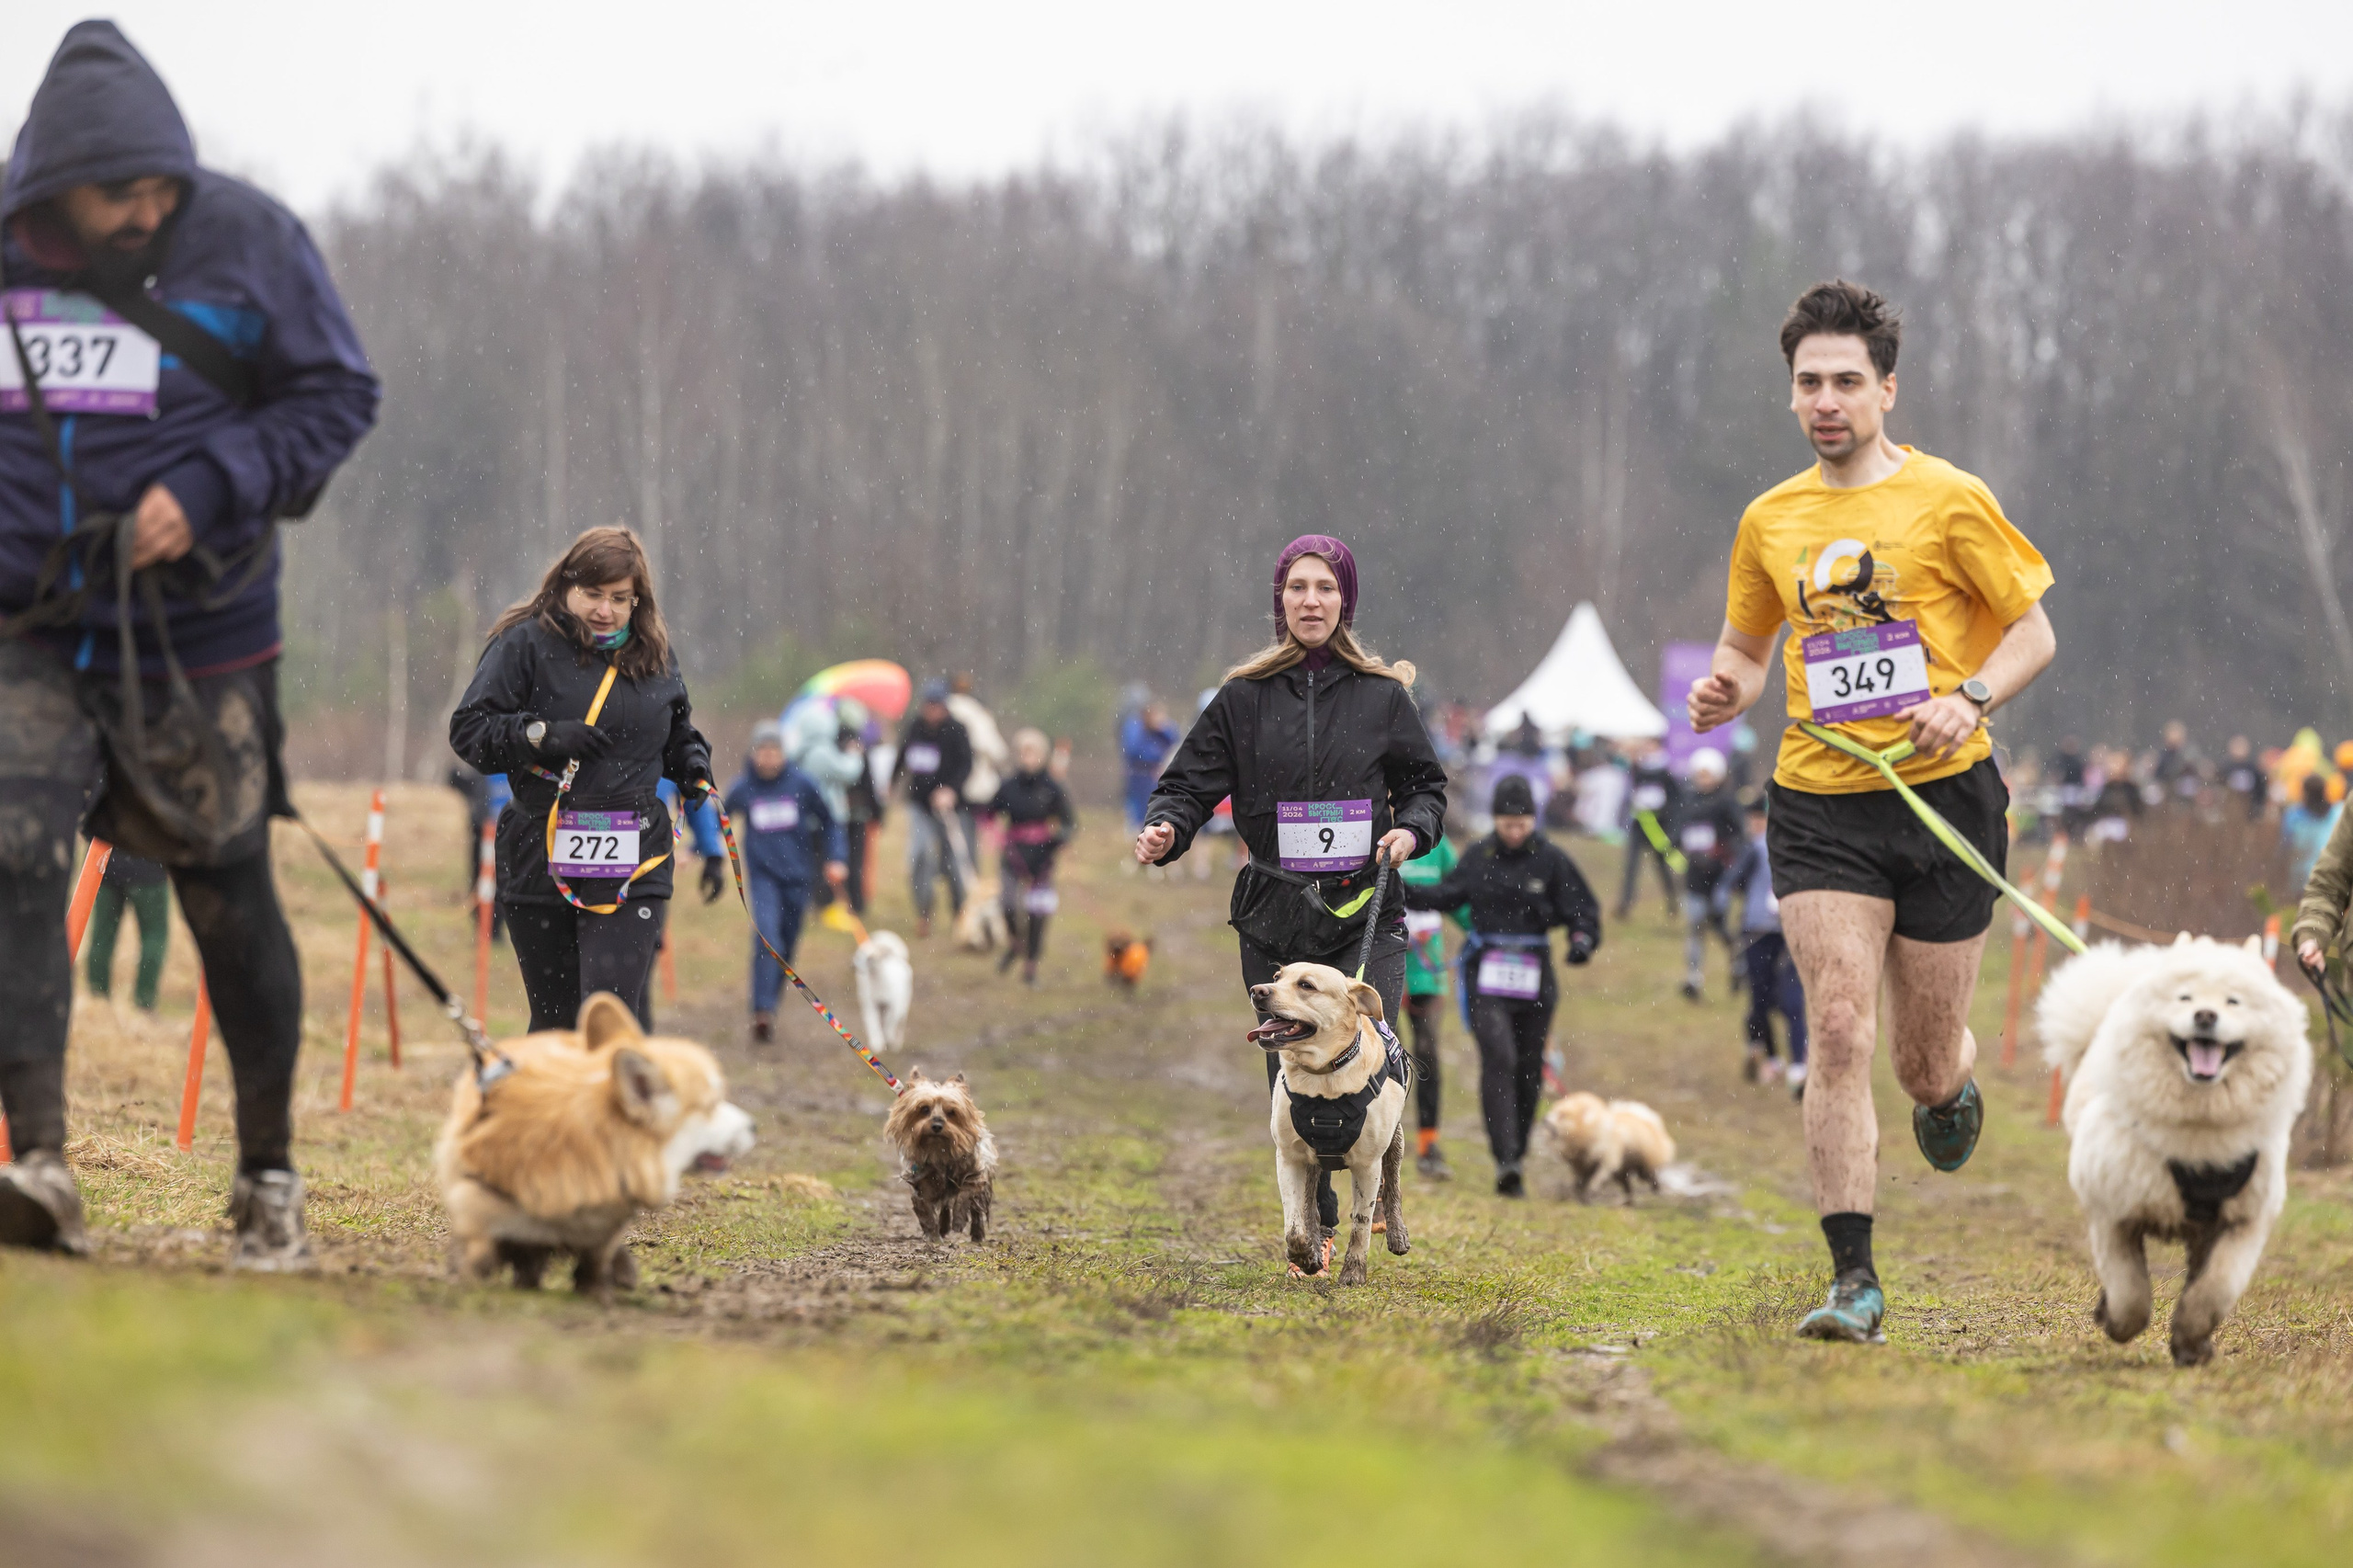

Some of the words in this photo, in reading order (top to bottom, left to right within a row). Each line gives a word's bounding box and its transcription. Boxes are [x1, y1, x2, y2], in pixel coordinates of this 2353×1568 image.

[25, 335, 119, 379] 337
[1832, 657, 1896, 699] 349
[569, 835, 620, 860] 272
[1318, 827, 1336, 854] 9
